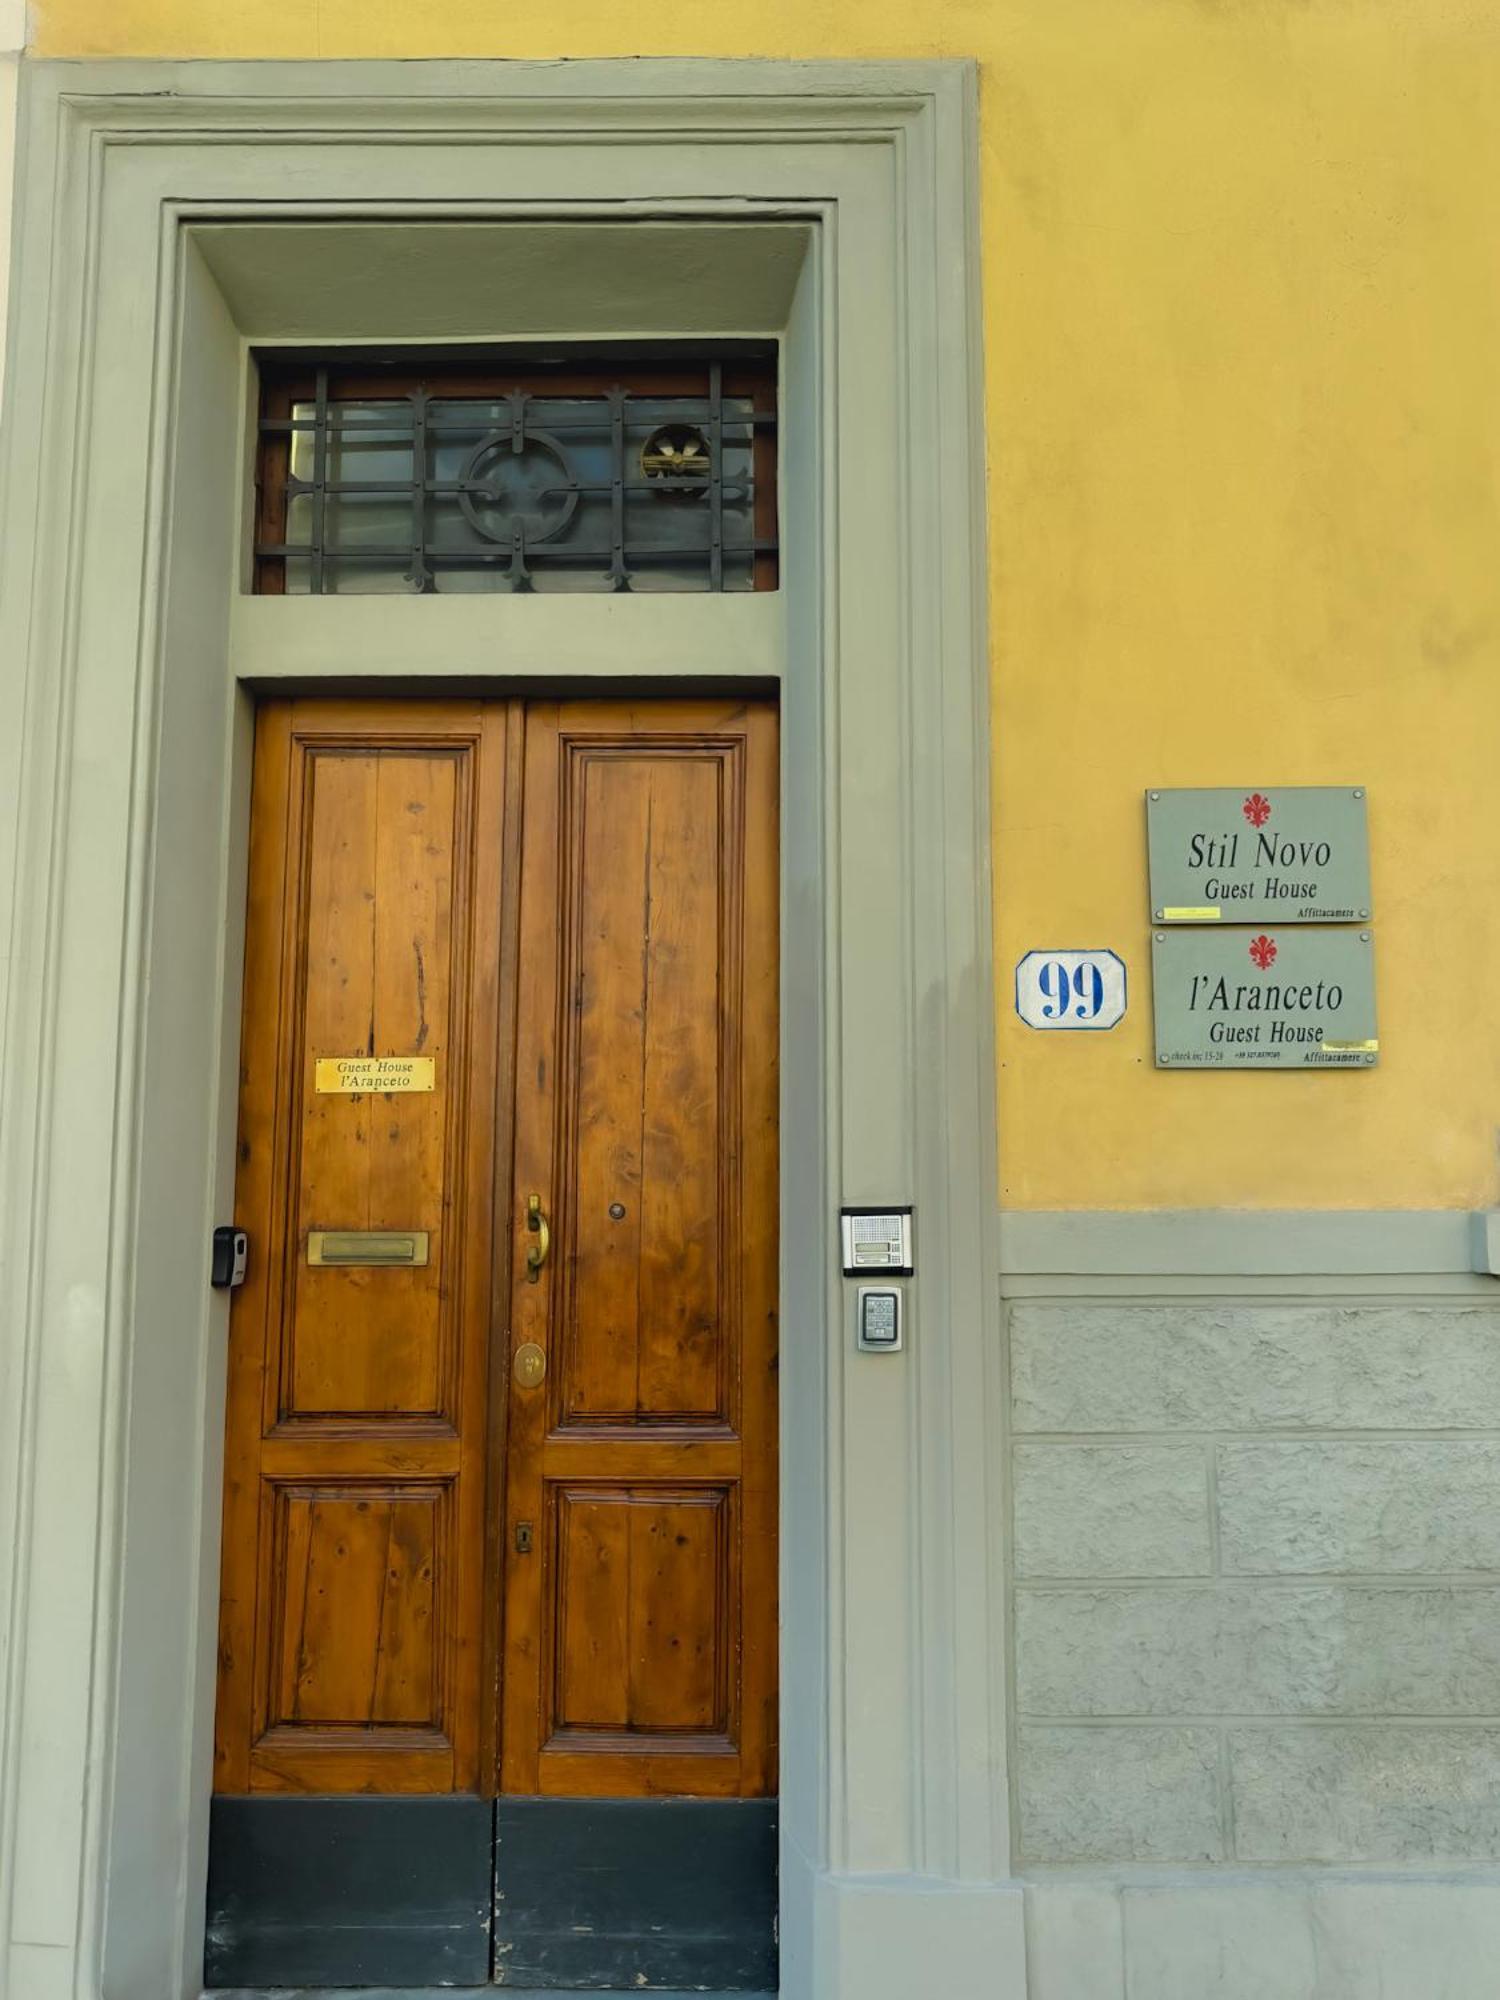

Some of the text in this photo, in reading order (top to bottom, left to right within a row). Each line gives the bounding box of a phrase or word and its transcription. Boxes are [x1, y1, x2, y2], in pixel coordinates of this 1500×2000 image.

[1188, 832, 1331, 868] Stil Novo
[1205, 878, 1317, 900] Guest House
[1039, 962, 1104, 1019] 99
[1189, 976, 1343, 1011] l'Aranceto
[1210, 1021, 1324, 1043] Guest House
[337, 1062, 414, 1073] Guest House
[341, 1075, 411, 1087] l'Aranceto
